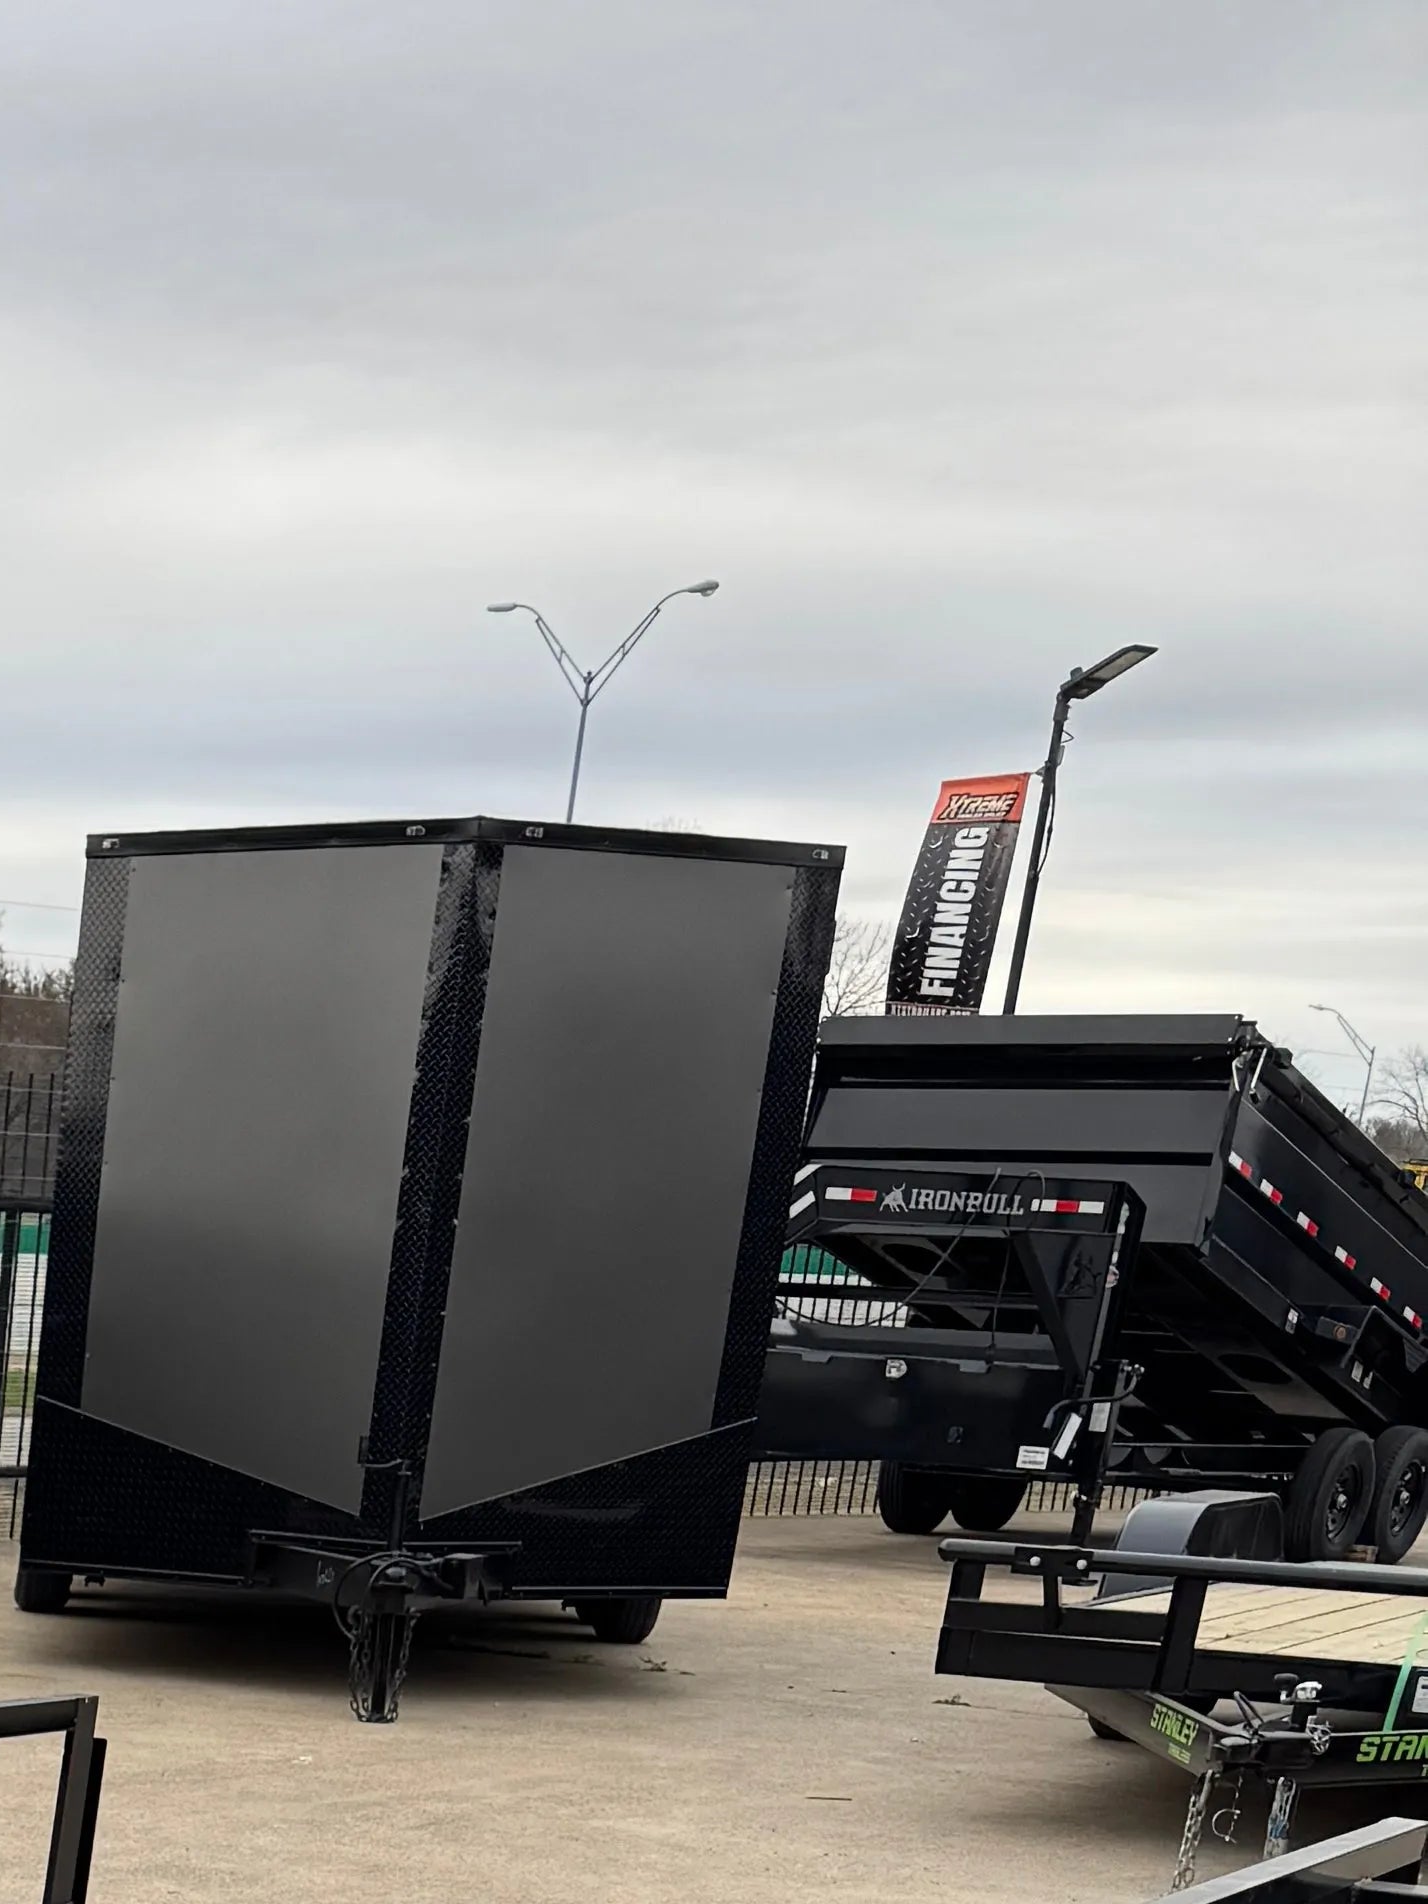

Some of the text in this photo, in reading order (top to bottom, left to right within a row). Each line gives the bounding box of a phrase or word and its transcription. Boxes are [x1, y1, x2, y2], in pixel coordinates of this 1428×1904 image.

[939, 794, 1018, 819] XTREME
[918, 827, 991, 998] FINANCING
[908, 1188, 1024, 1216] IRONBULL
[1150, 1703, 1200, 1746] STANLEY
